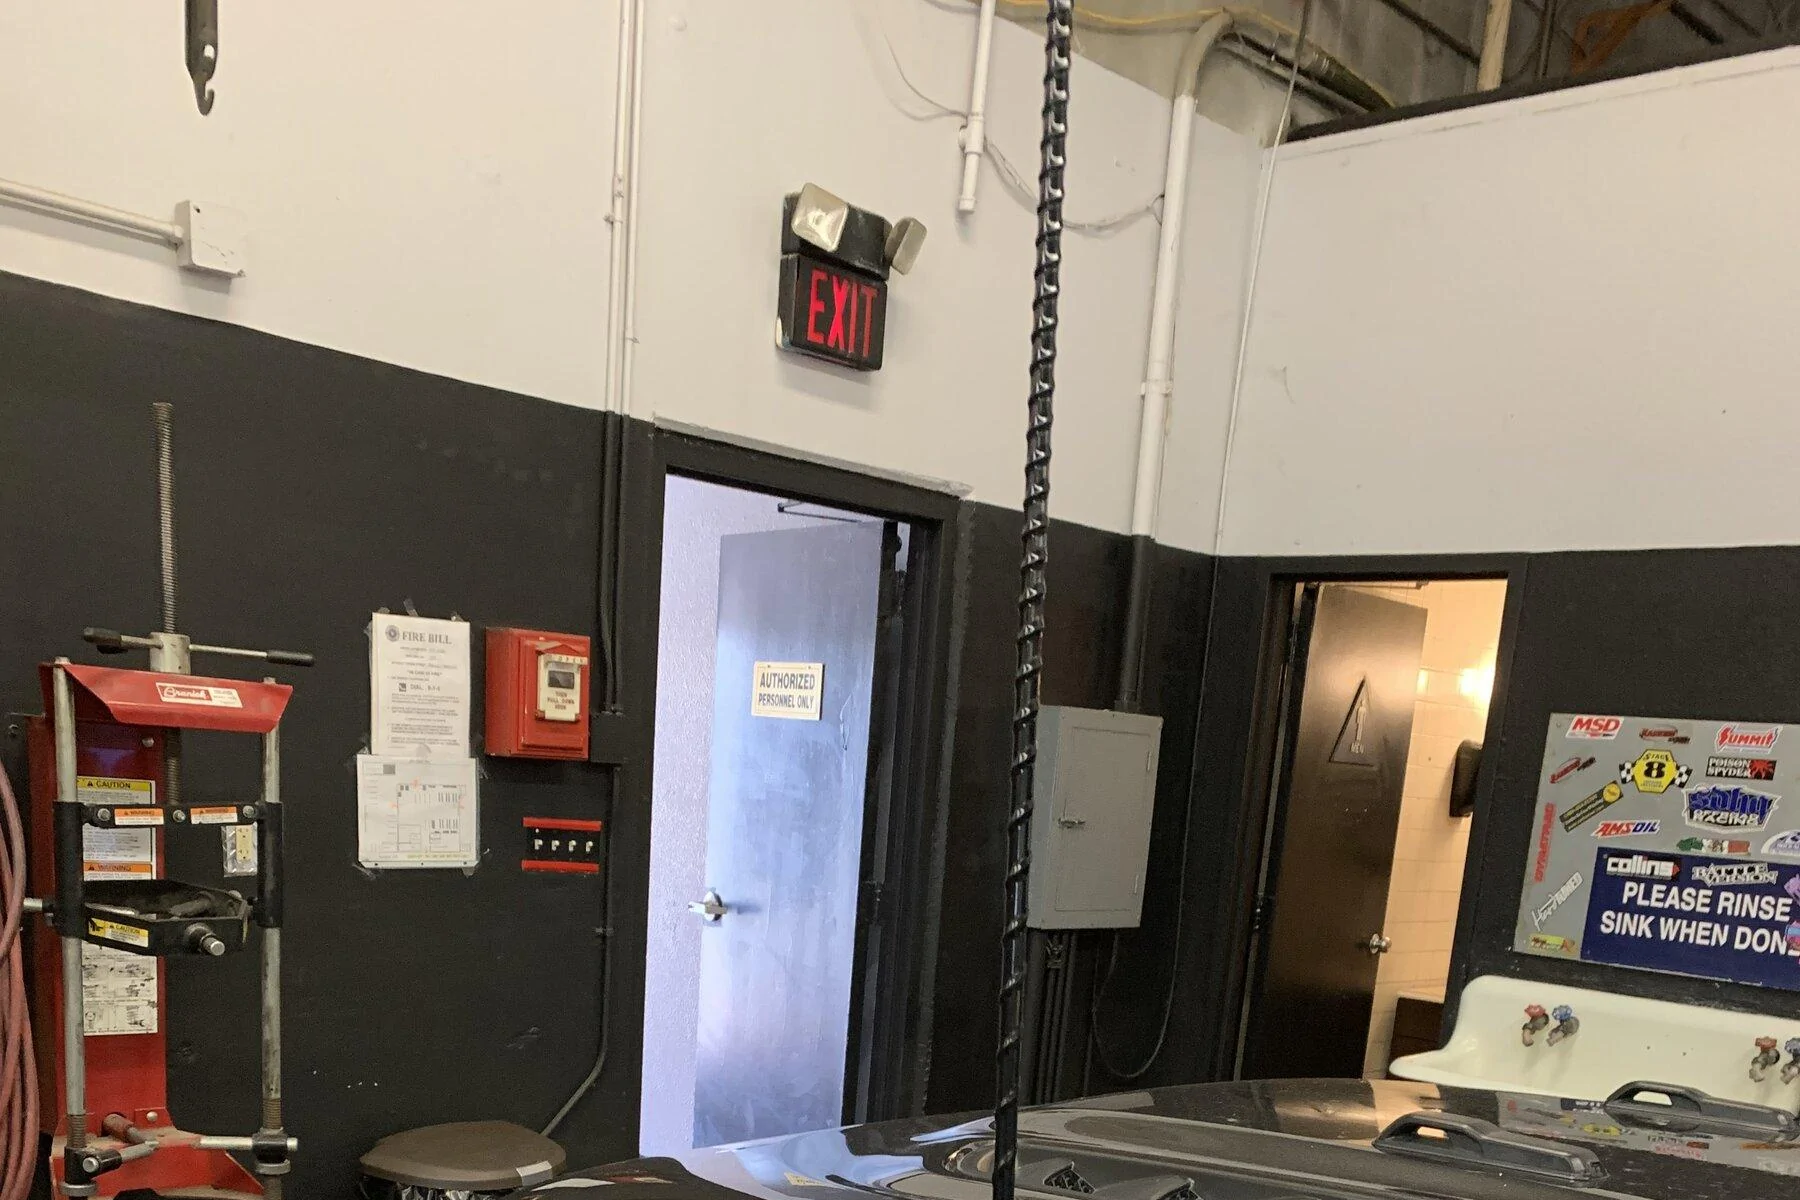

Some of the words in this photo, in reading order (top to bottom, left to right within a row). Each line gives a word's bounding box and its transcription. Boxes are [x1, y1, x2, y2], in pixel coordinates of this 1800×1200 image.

[807, 268, 879, 358] EXIT
[402, 631, 426, 642] FIRE
[428, 633, 452, 645] BILL
[760, 672, 815, 691] AUTHORIZED
[758, 693, 795, 709] PERSONNEL
[797, 695, 814, 710] ONLY
[1572, 717, 1620, 732] MSD
[1644, 761, 1666, 778] 8
[1709, 757, 1750, 768] POISON
[96, 781, 131, 789] CAUTION
[1596, 820, 1658, 837] AMSOIL
[1606, 855, 1675, 876] collins
[1622, 881, 1713, 914] PLEASE
[1717, 891, 1793, 922] RINSE
[1600, 910, 1655, 939] SINK
[1660, 916, 1729, 946] WHEN
[1734, 926, 1800, 957] DON
